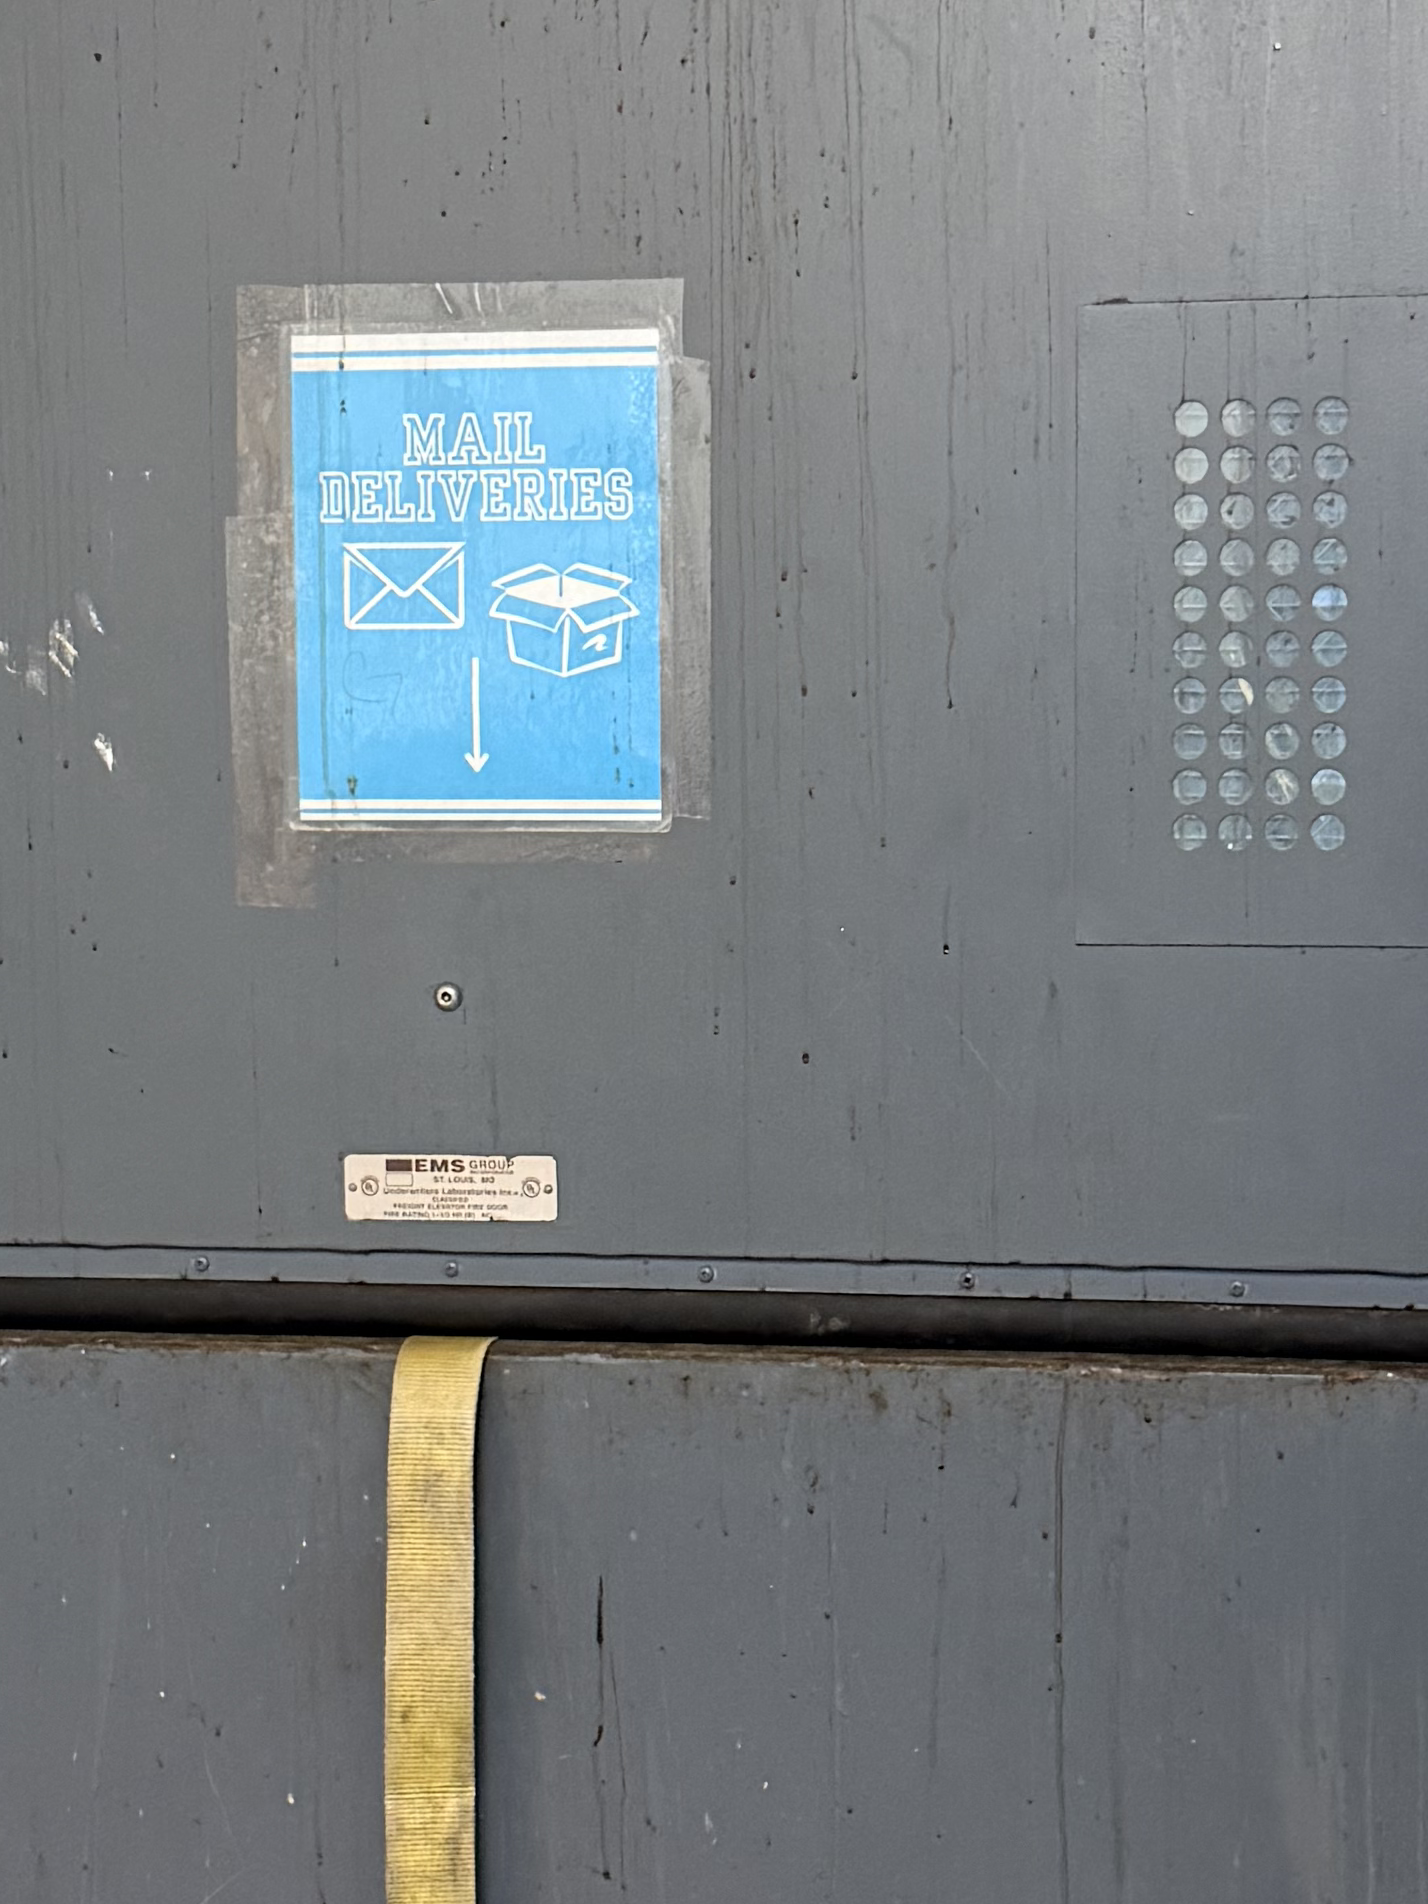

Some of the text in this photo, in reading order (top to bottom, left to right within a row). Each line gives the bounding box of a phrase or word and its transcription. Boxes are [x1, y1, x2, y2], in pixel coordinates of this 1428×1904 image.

[402, 411, 546, 466] MAIL
[319, 468, 634, 524] DELIVERIES
[414, 1158, 515, 1173] EMS GROUP
